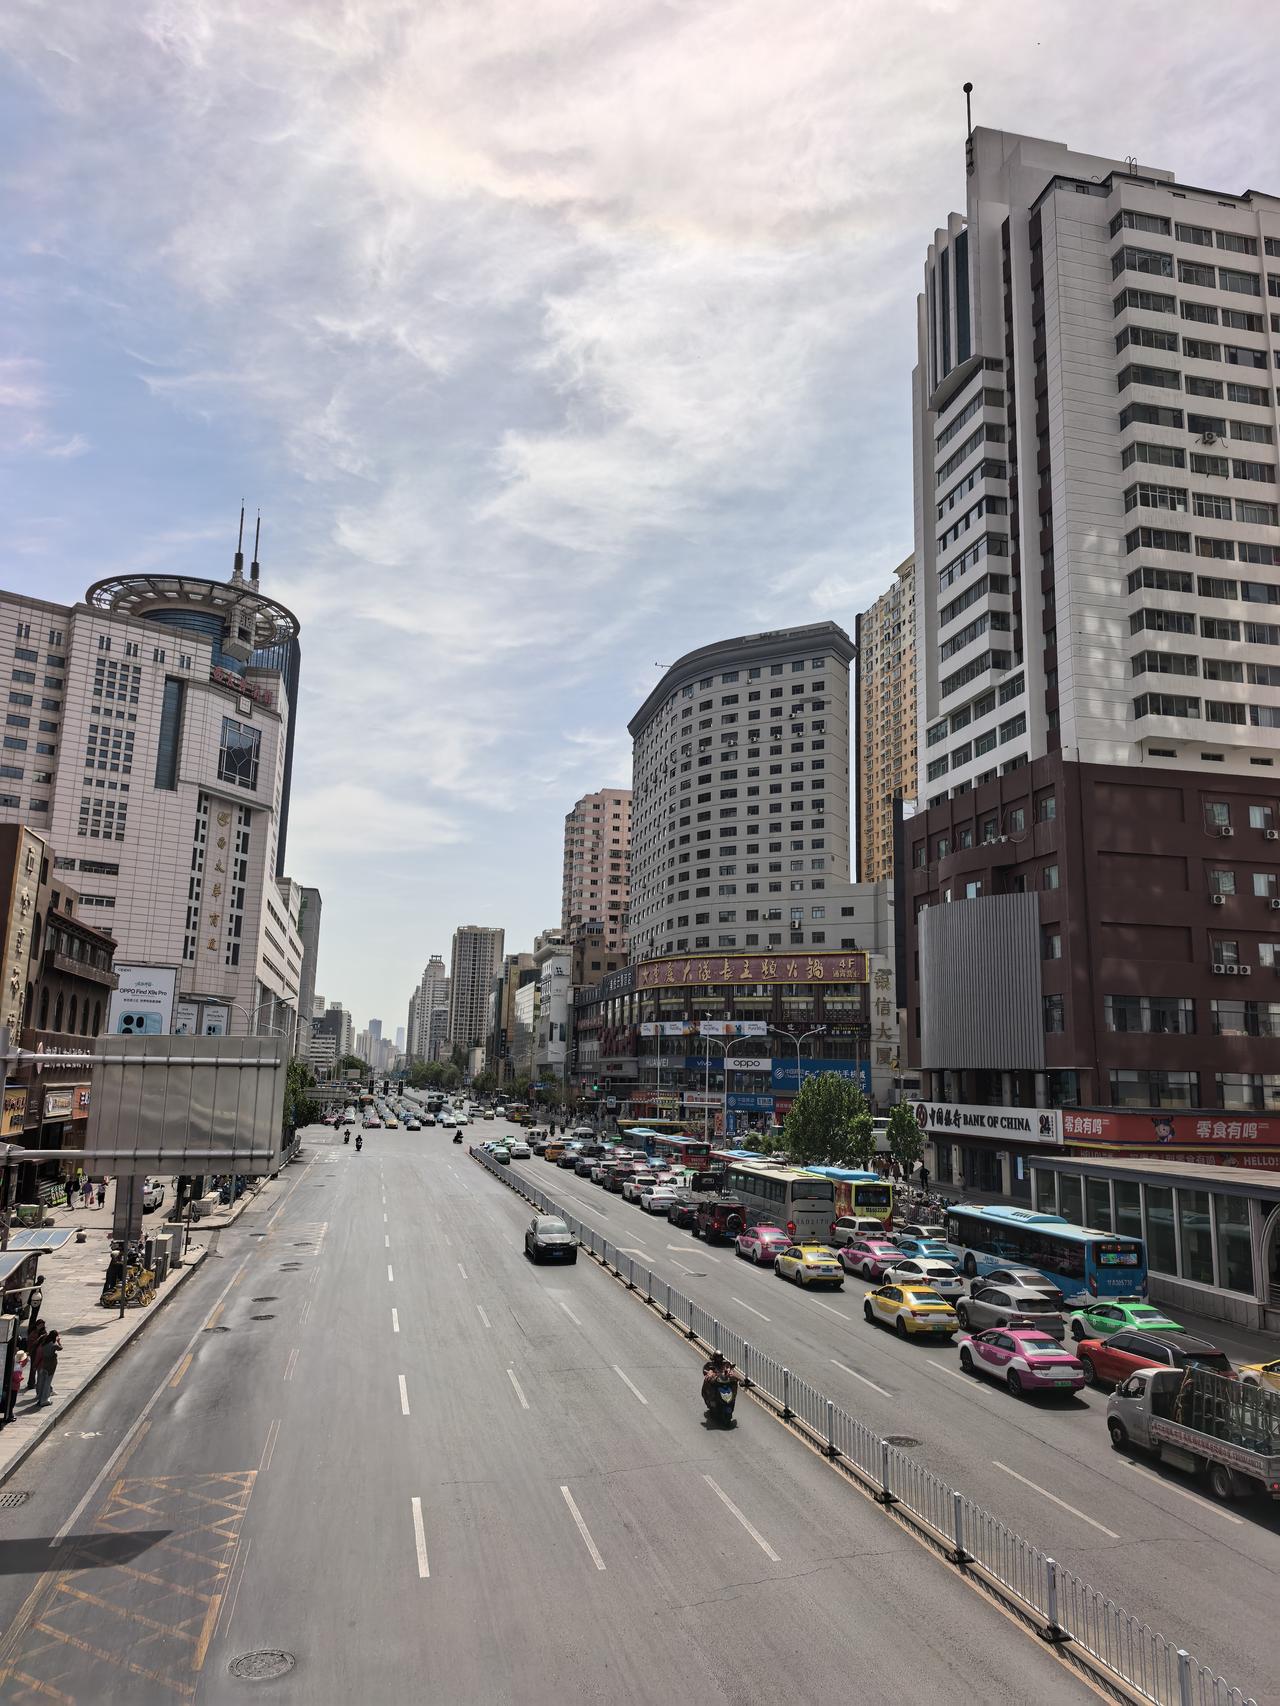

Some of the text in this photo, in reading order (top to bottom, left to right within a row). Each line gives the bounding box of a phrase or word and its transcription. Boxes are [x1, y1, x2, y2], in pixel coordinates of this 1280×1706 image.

[839, 958, 855, 968] 4F
[963, 1114, 1031, 1132] BANK OF CHINA
[1064, 1116, 1102, 1135] 零食有鸣
[1196, 1120, 1258, 1139] 零食有鸣
